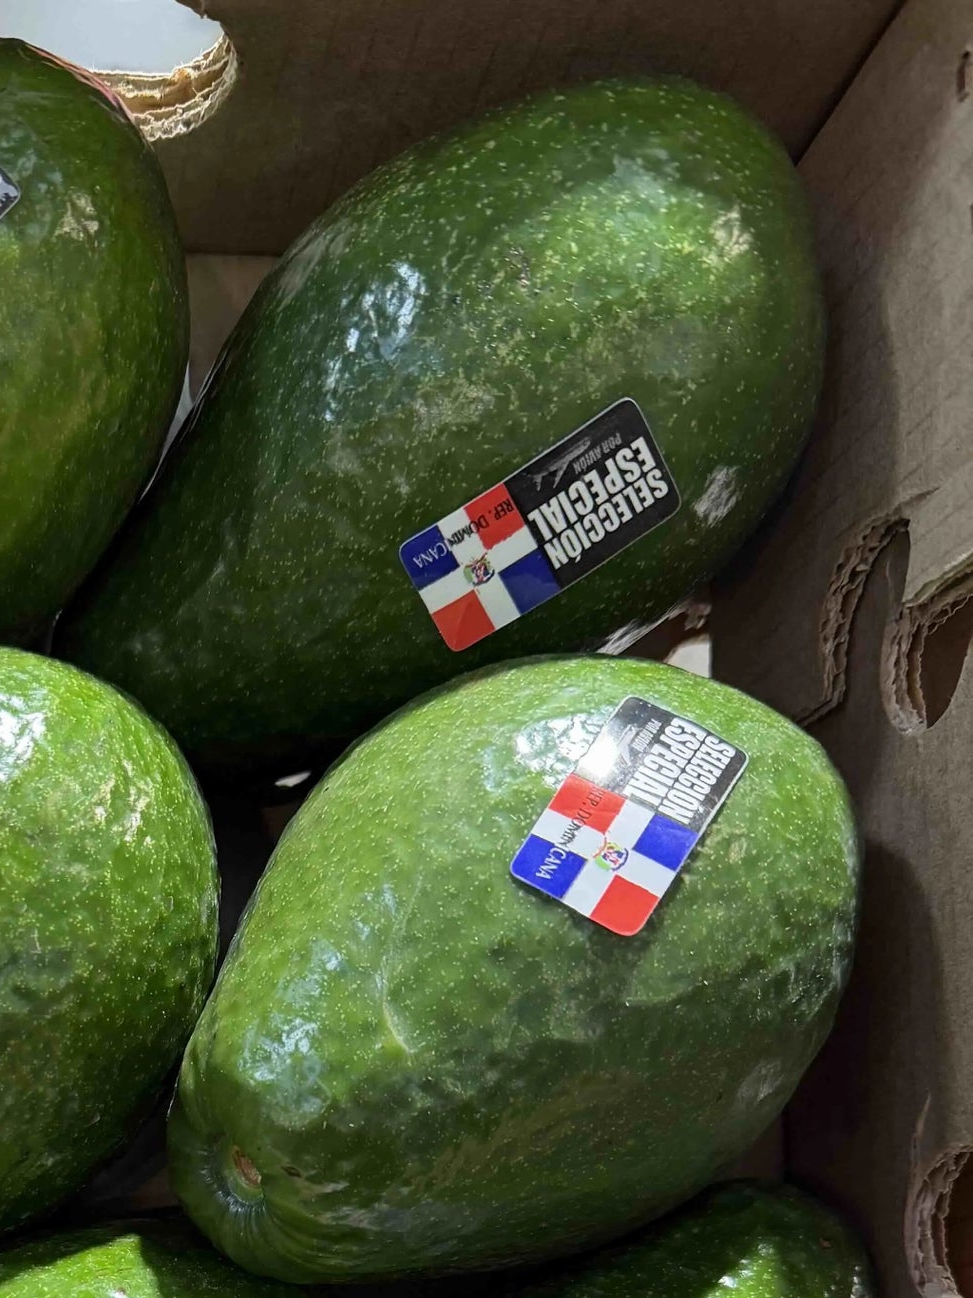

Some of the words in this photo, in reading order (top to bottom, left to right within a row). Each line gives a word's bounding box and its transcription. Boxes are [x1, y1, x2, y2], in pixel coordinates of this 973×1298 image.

[600, 433, 622, 453] POR
[488, 499, 514, 521] REP.
[528, 436, 656, 539] ESPECIAL
[543, 468, 668, 570] SELECCIÓN
[413, 515, 489, 568] DOMINICANA
[646, 719, 662, 734] POR
[622, 717, 707, 811] ESPECIAL
[659, 735, 735, 825] SELECCIÓN
[535, 806, 591, 880] DOMINICANA
